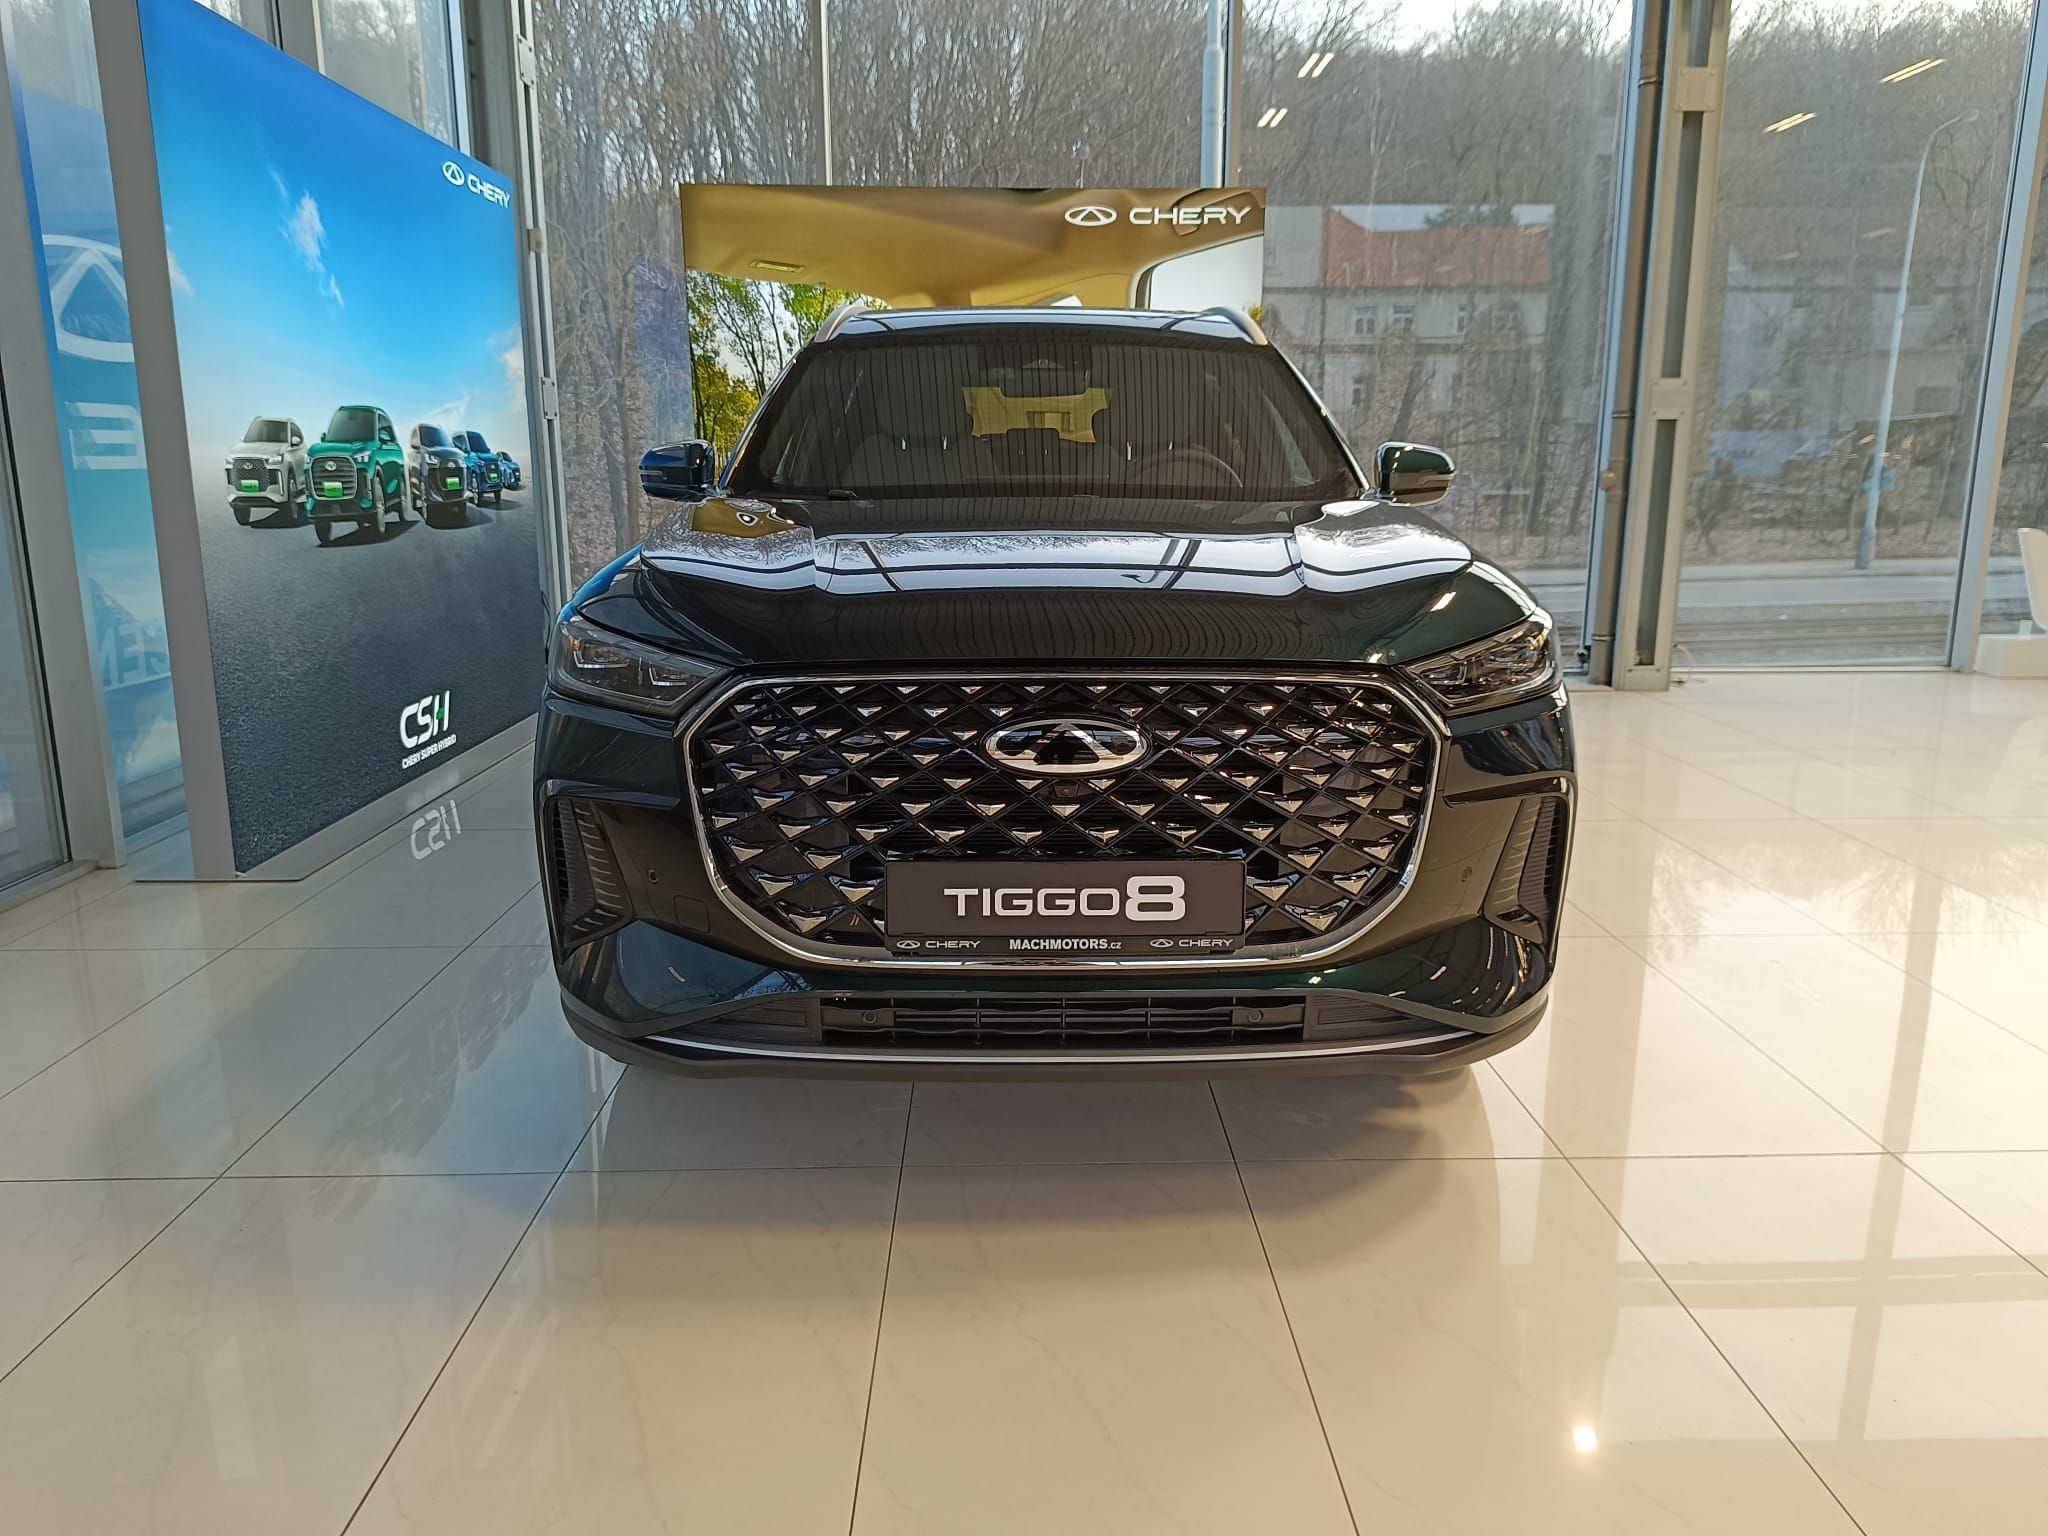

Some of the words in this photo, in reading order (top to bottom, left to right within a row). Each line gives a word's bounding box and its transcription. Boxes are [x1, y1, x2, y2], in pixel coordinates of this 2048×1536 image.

[467, 173, 510, 209] CHERY
[1129, 207, 1251, 225] CHERY
[400, 690, 450, 749] CSH
[421, 743, 438, 760] SUPER
[925, 940, 981, 949] CHERY
[1178, 938, 1234, 948] CHERY
